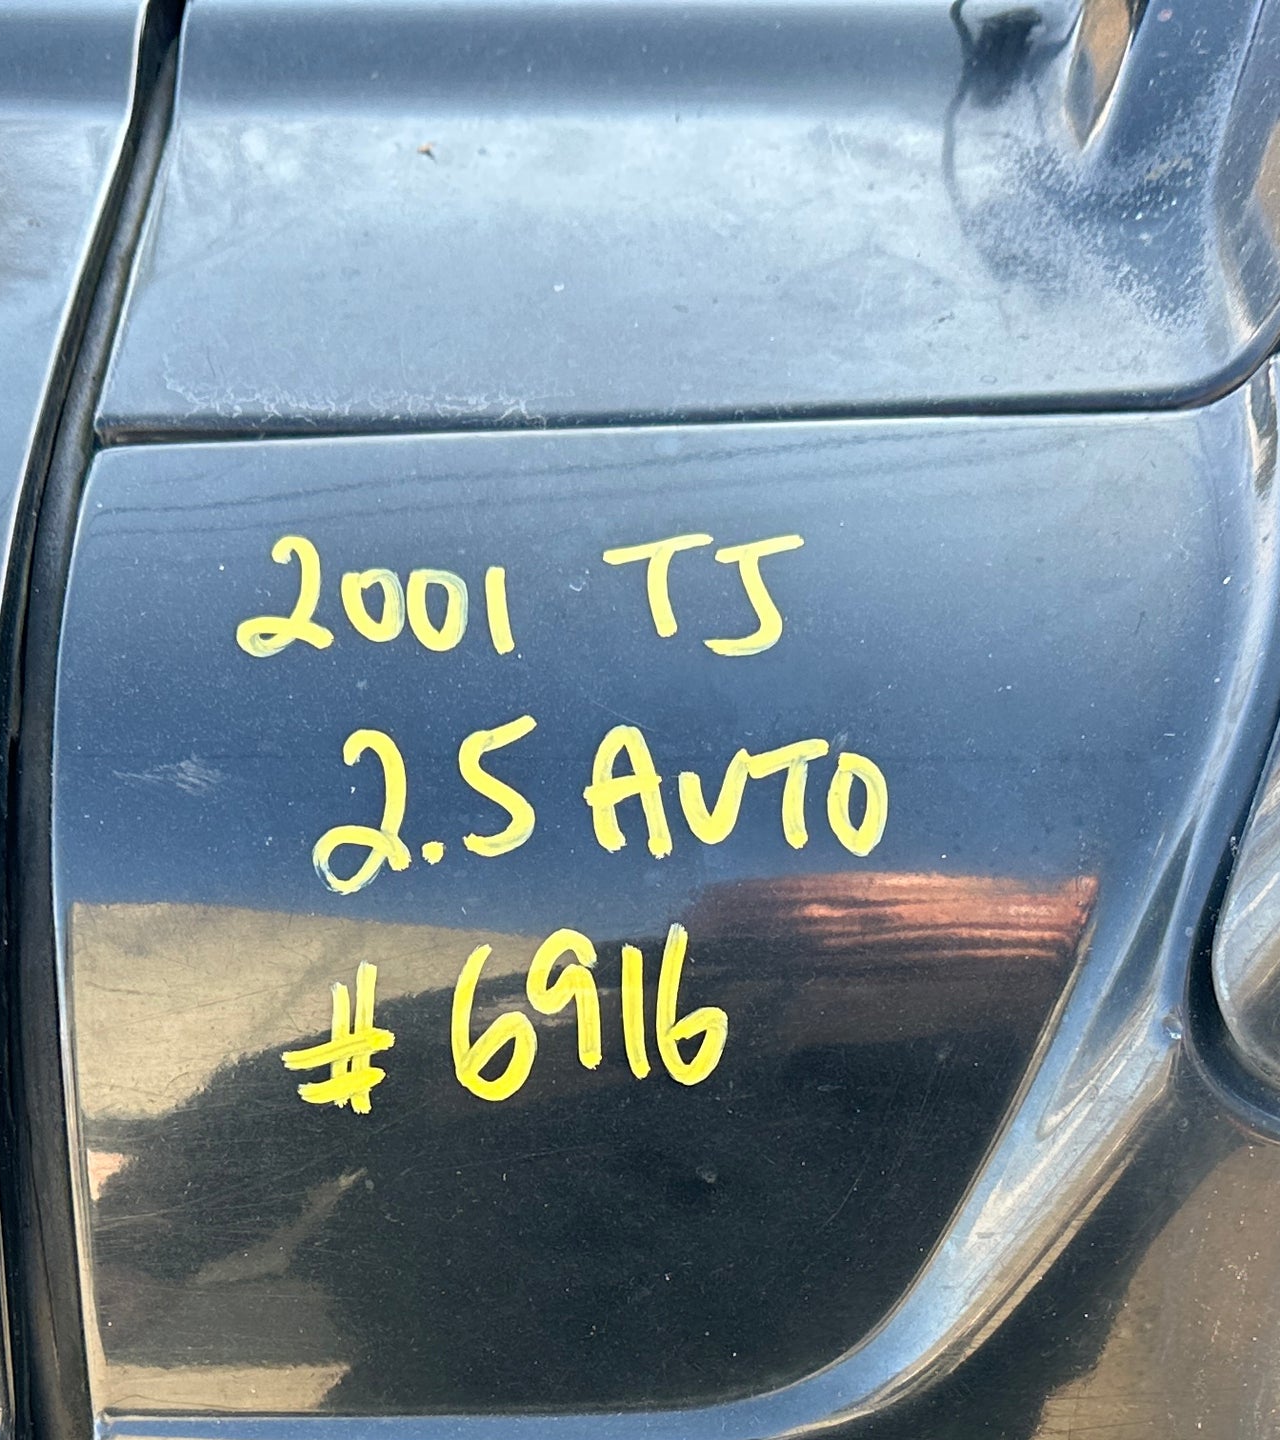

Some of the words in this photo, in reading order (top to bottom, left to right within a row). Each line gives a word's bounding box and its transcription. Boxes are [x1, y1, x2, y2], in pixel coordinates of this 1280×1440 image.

[236, 535, 515, 657] 2001
[603, 534, 804, 656] TJ
[312, 715, 536, 894] 2.5
[584, 724, 888, 859] AUTO
[281, 961, 395, 1114] #
[450, 923, 728, 1101] 6916
